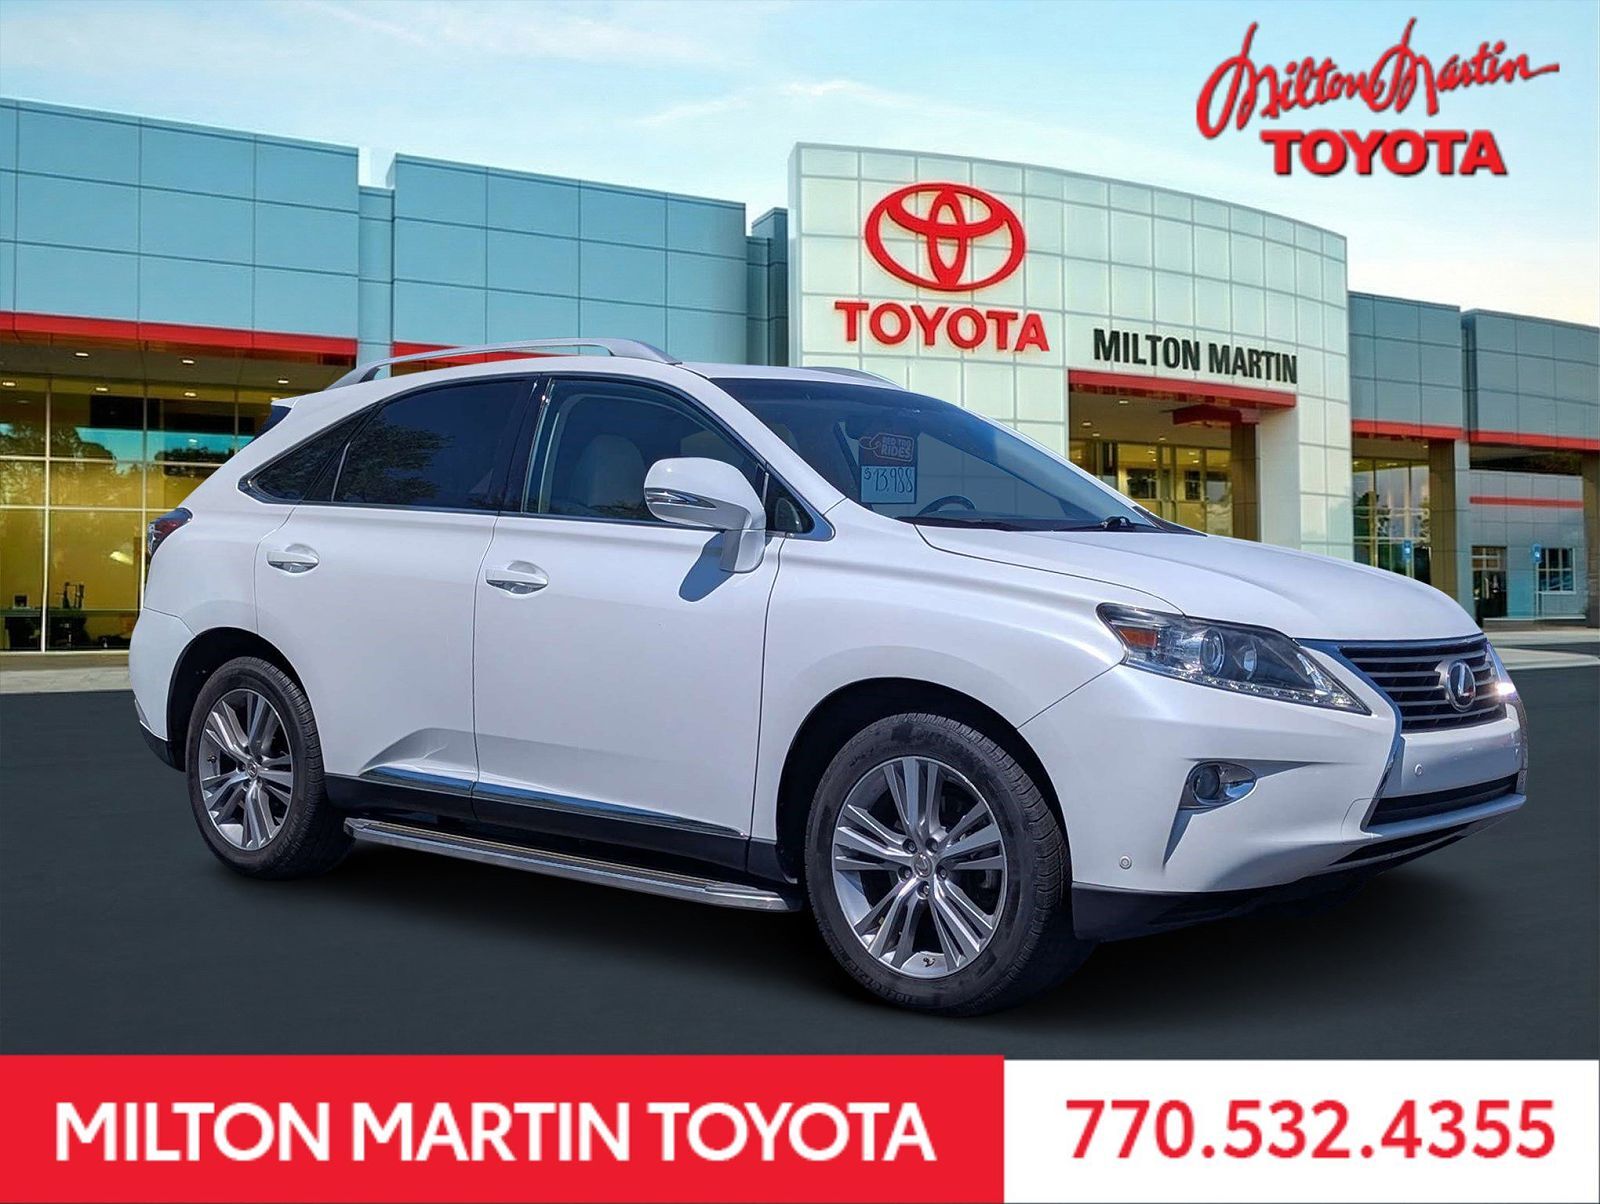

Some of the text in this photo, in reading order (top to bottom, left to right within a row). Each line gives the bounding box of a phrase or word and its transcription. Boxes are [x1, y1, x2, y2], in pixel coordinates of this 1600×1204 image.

[835, 301, 1049, 352] TOYOTA
[1094, 328, 1297, 384] MILTON MARTIN
[881, 444, 911, 459] RIDES
